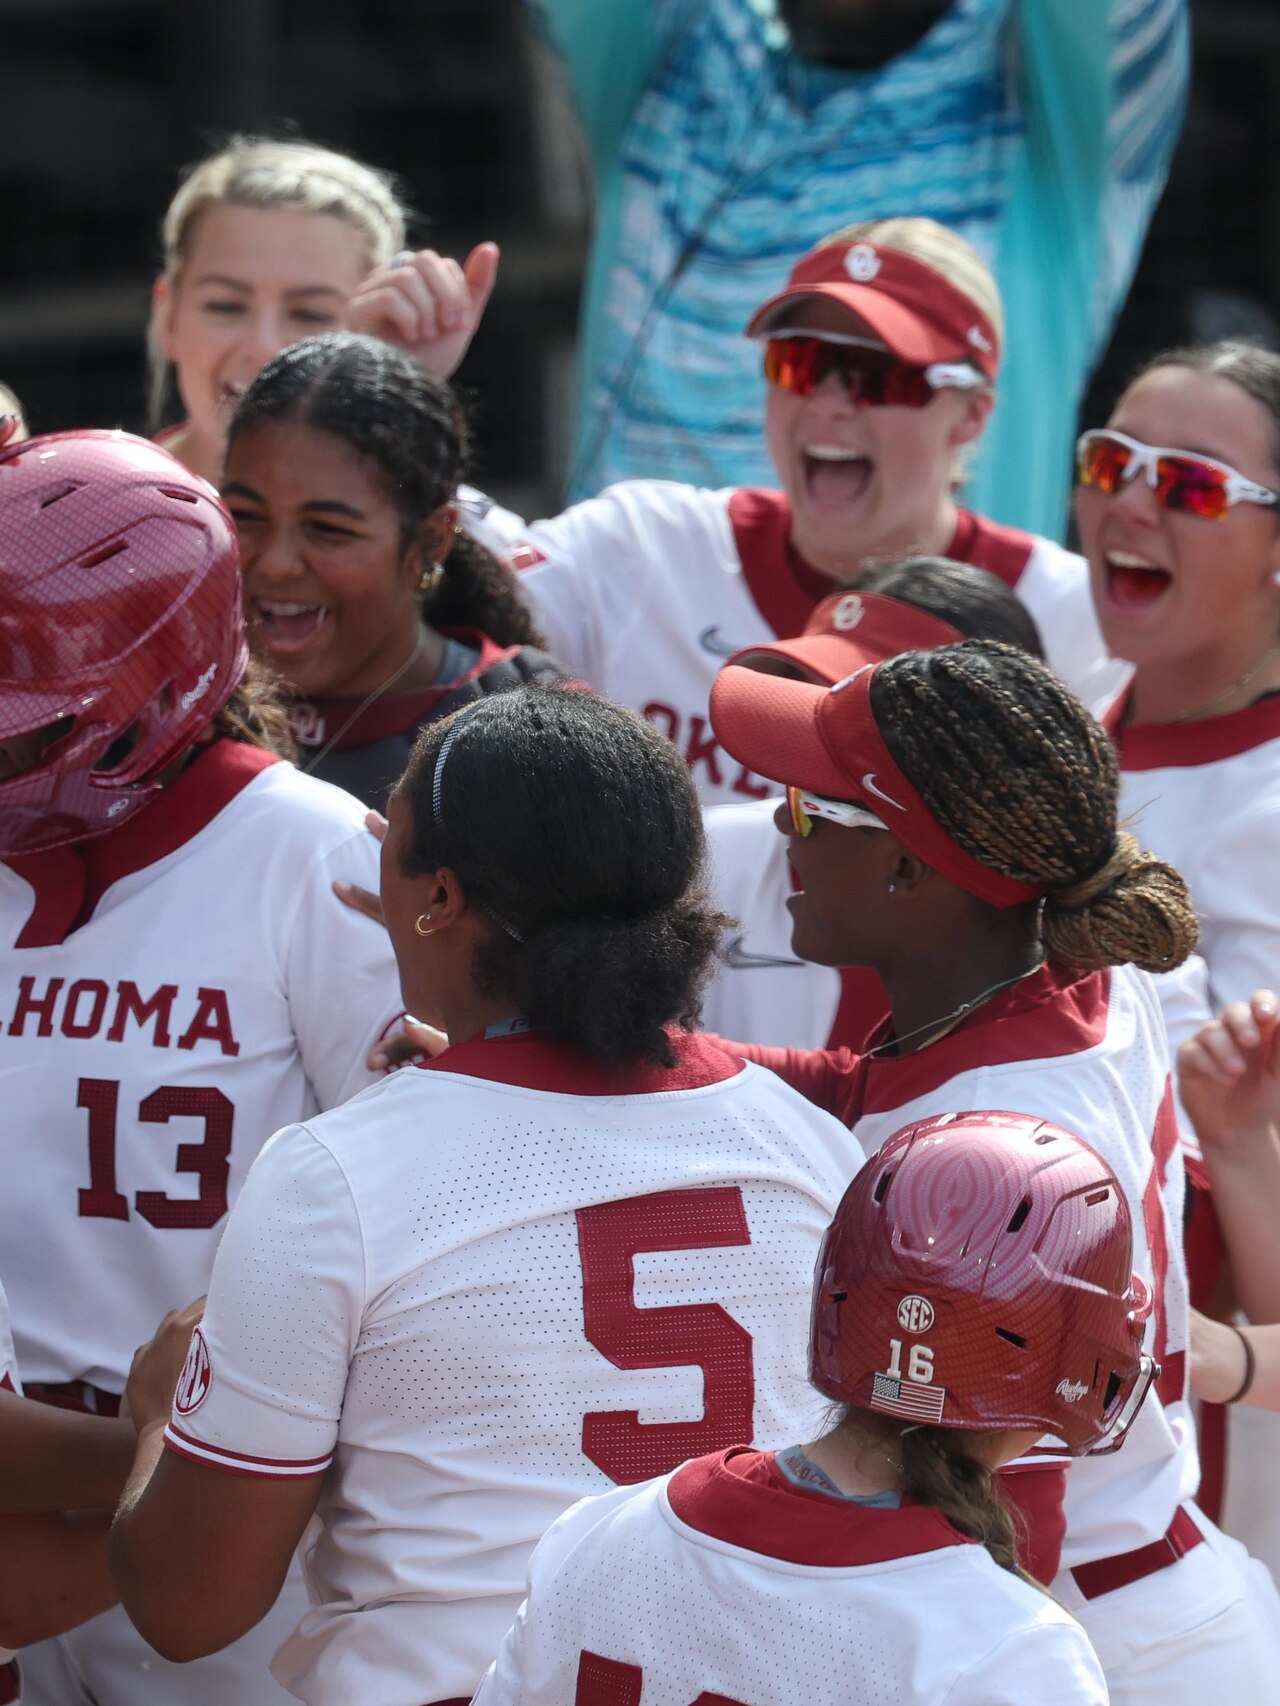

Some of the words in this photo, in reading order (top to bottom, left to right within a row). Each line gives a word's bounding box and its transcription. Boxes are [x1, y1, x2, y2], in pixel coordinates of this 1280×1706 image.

[76, 1077, 235, 1229] 13
[575, 1186, 754, 1486] 5
[886, 1338, 935, 1385] 16
[898, 1297, 932, 1332] SEC
